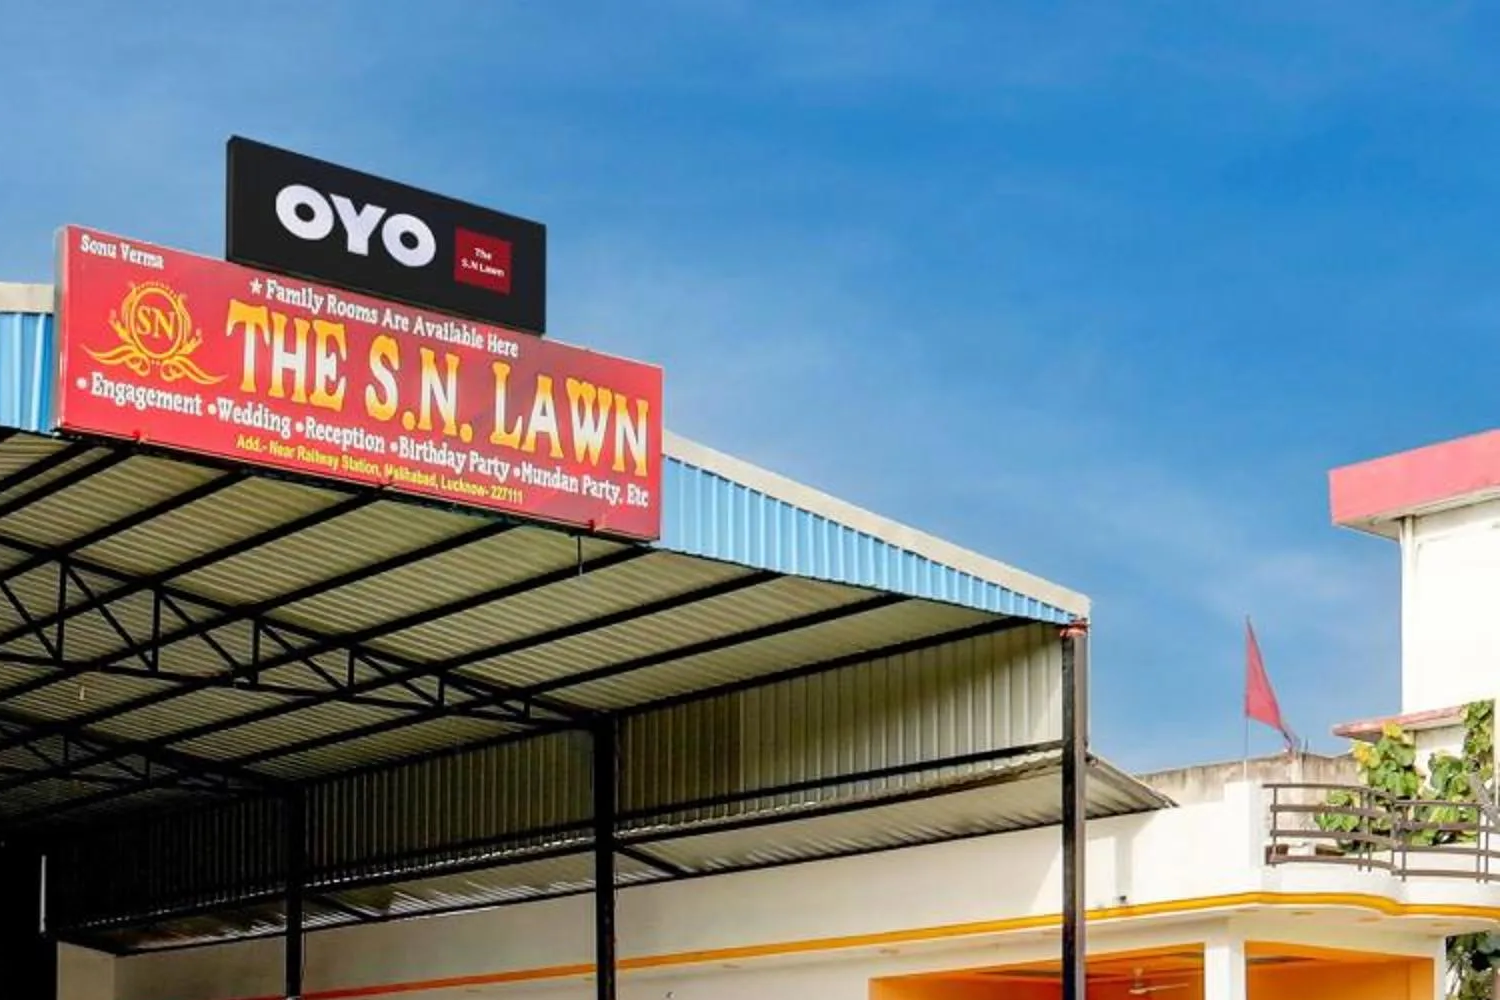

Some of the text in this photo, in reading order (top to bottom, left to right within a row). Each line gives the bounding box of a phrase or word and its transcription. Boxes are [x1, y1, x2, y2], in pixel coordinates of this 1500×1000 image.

[80, 234, 165, 270] Sonu Verma
[275, 184, 436, 267] OYO
[136, 305, 176, 340] SN
[265, 278, 519, 358] Family Rooms Are Available Here
[225, 299, 649, 477] THE S.N. LAWN
[468, 449, 511, 484] Party
